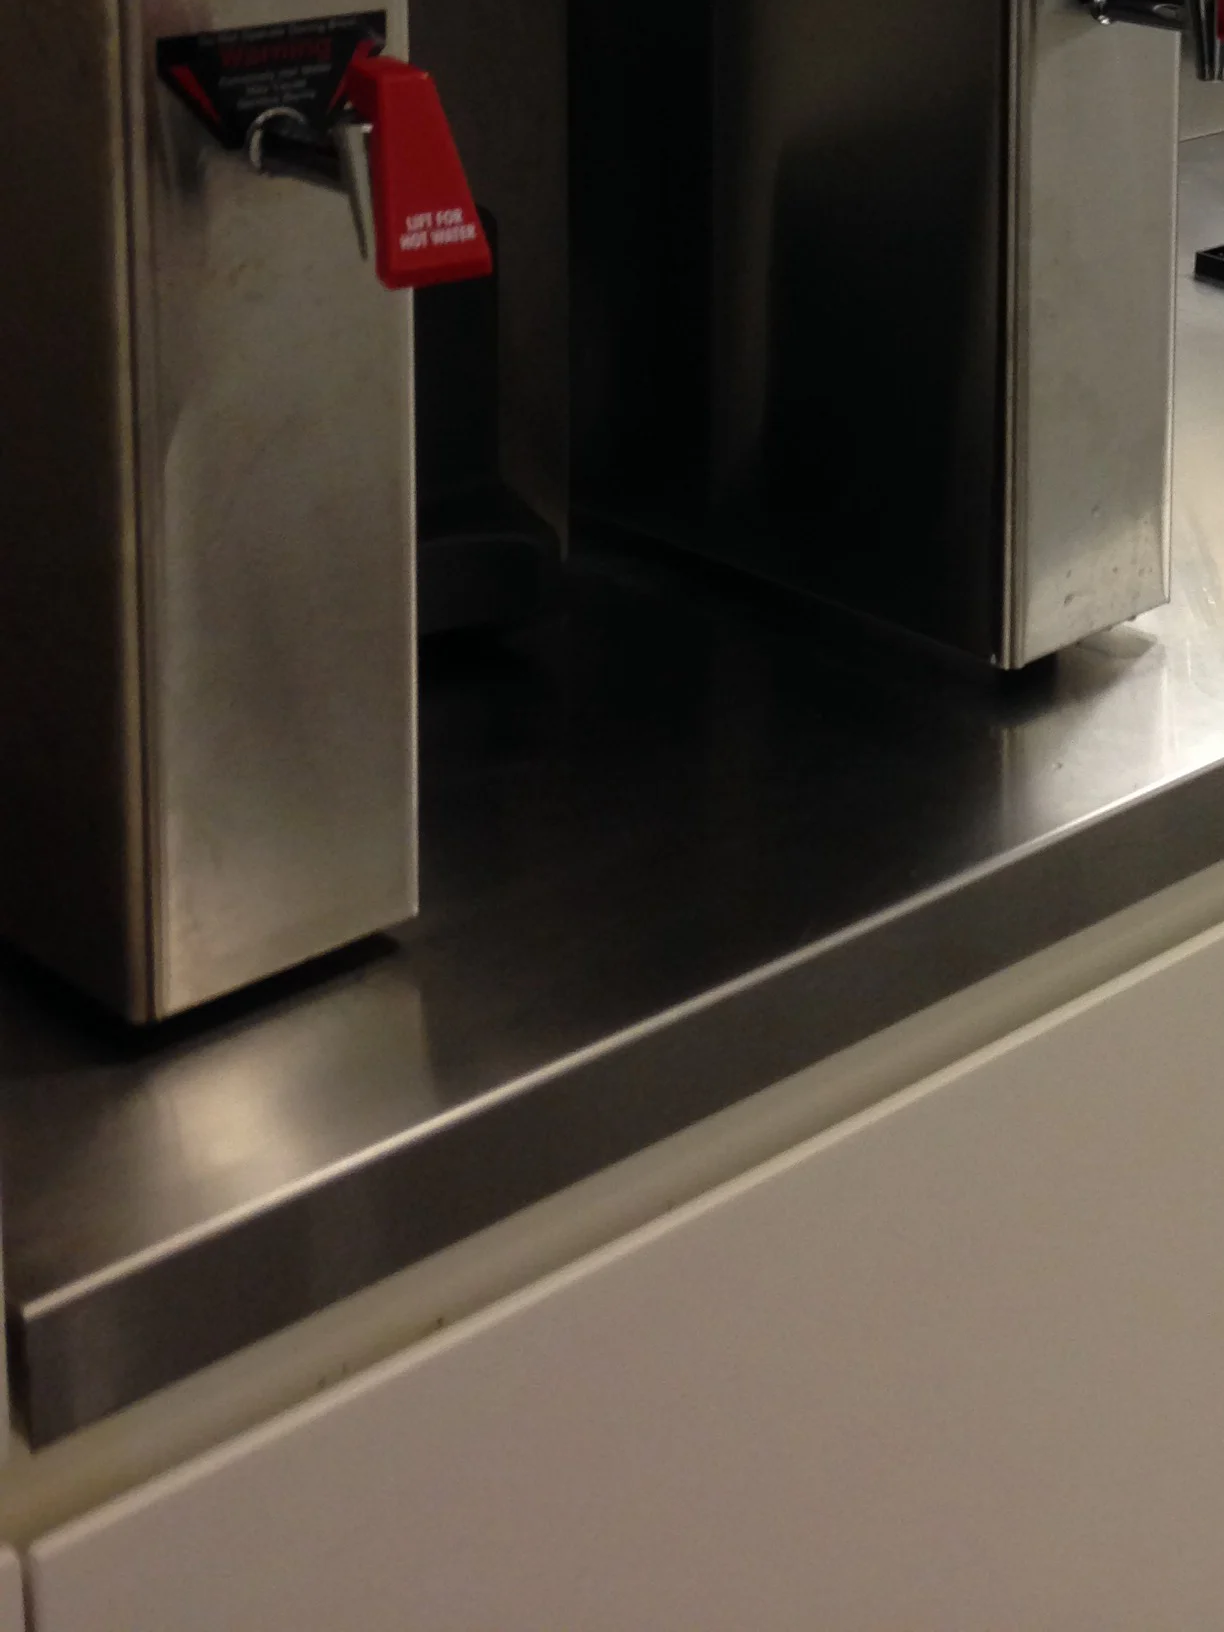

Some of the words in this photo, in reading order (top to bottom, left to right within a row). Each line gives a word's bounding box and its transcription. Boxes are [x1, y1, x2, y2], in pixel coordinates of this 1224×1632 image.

[436, 207, 464, 227] FOR
[399, 230, 428, 252] HOT
[430, 222, 477, 247] WATER
